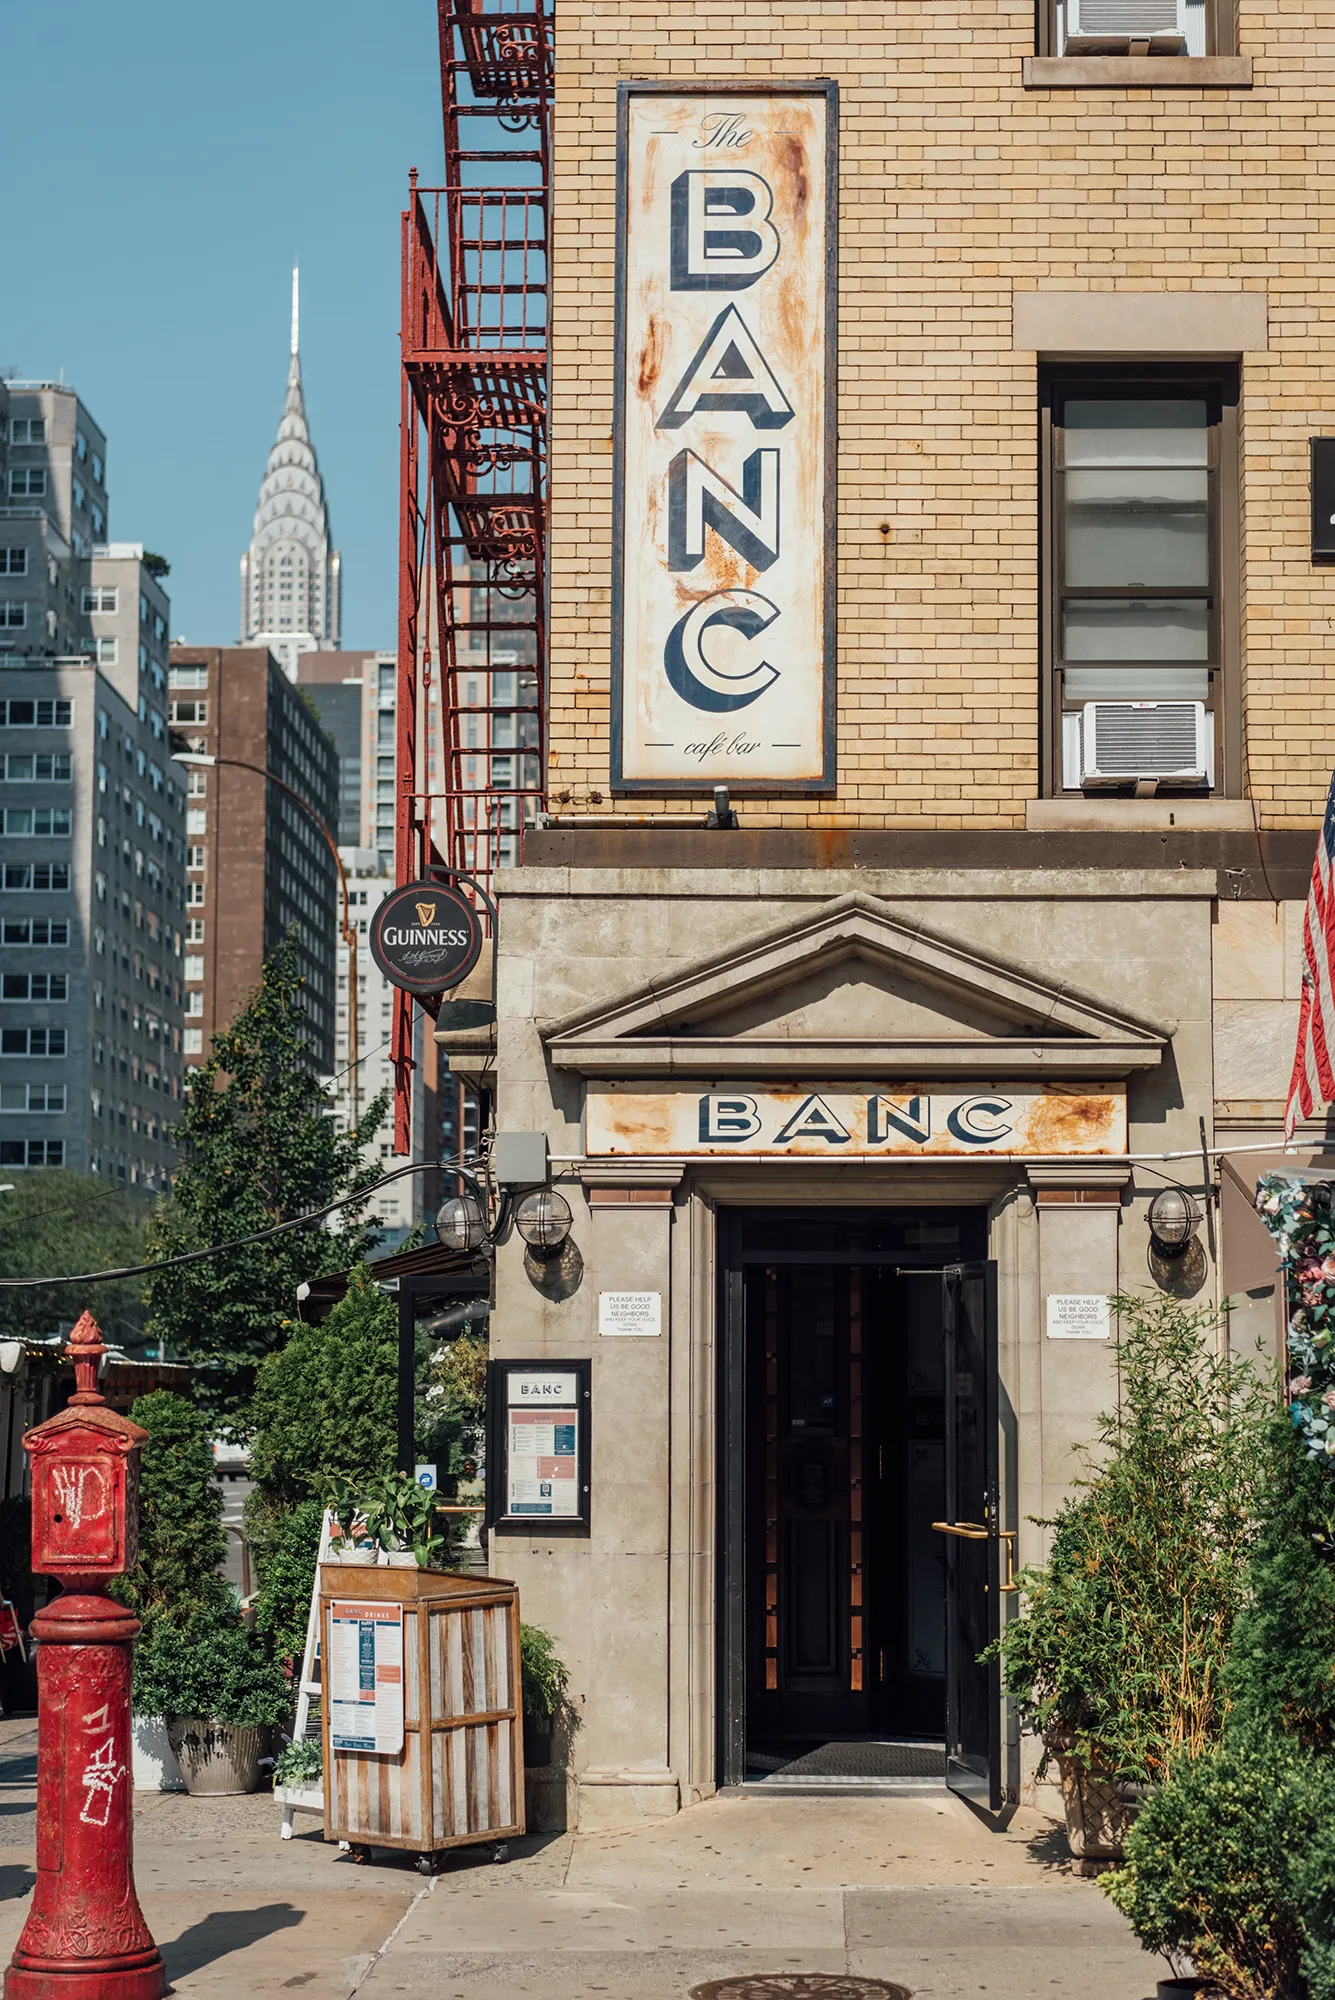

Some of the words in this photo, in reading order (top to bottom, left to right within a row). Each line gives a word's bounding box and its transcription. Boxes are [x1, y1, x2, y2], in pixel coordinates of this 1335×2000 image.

[692, 112, 754, 149] The
[654, 169, 796, 713] BANC
[683, 731, 728, 763] café
[725, 731, 761, 755] bar
[383, 926, 468, 946] GUINNESS
[698, 1093, 1013, 1144] BANC
[521, 1385, 563, 1394] BANC
[344, 1607, 362, 1616] BANC
